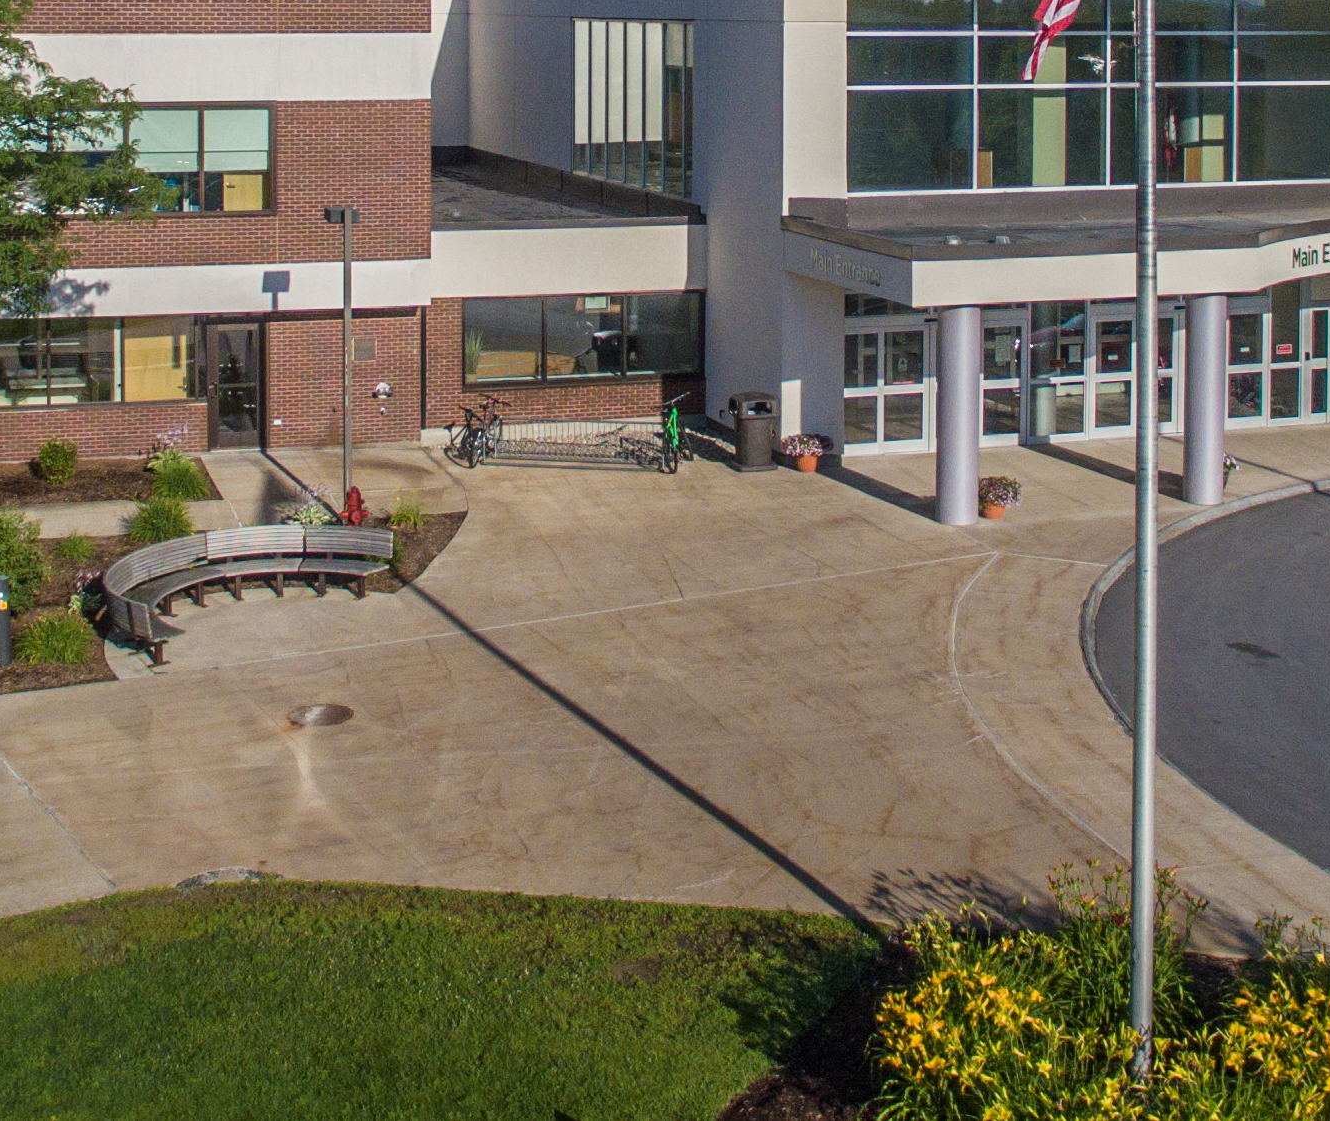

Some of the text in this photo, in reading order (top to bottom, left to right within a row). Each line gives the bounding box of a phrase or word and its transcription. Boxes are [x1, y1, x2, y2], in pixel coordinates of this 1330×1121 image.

[809, 247, 881, 286] Main Entrance
[1292, 245, 1319, 268] Main
